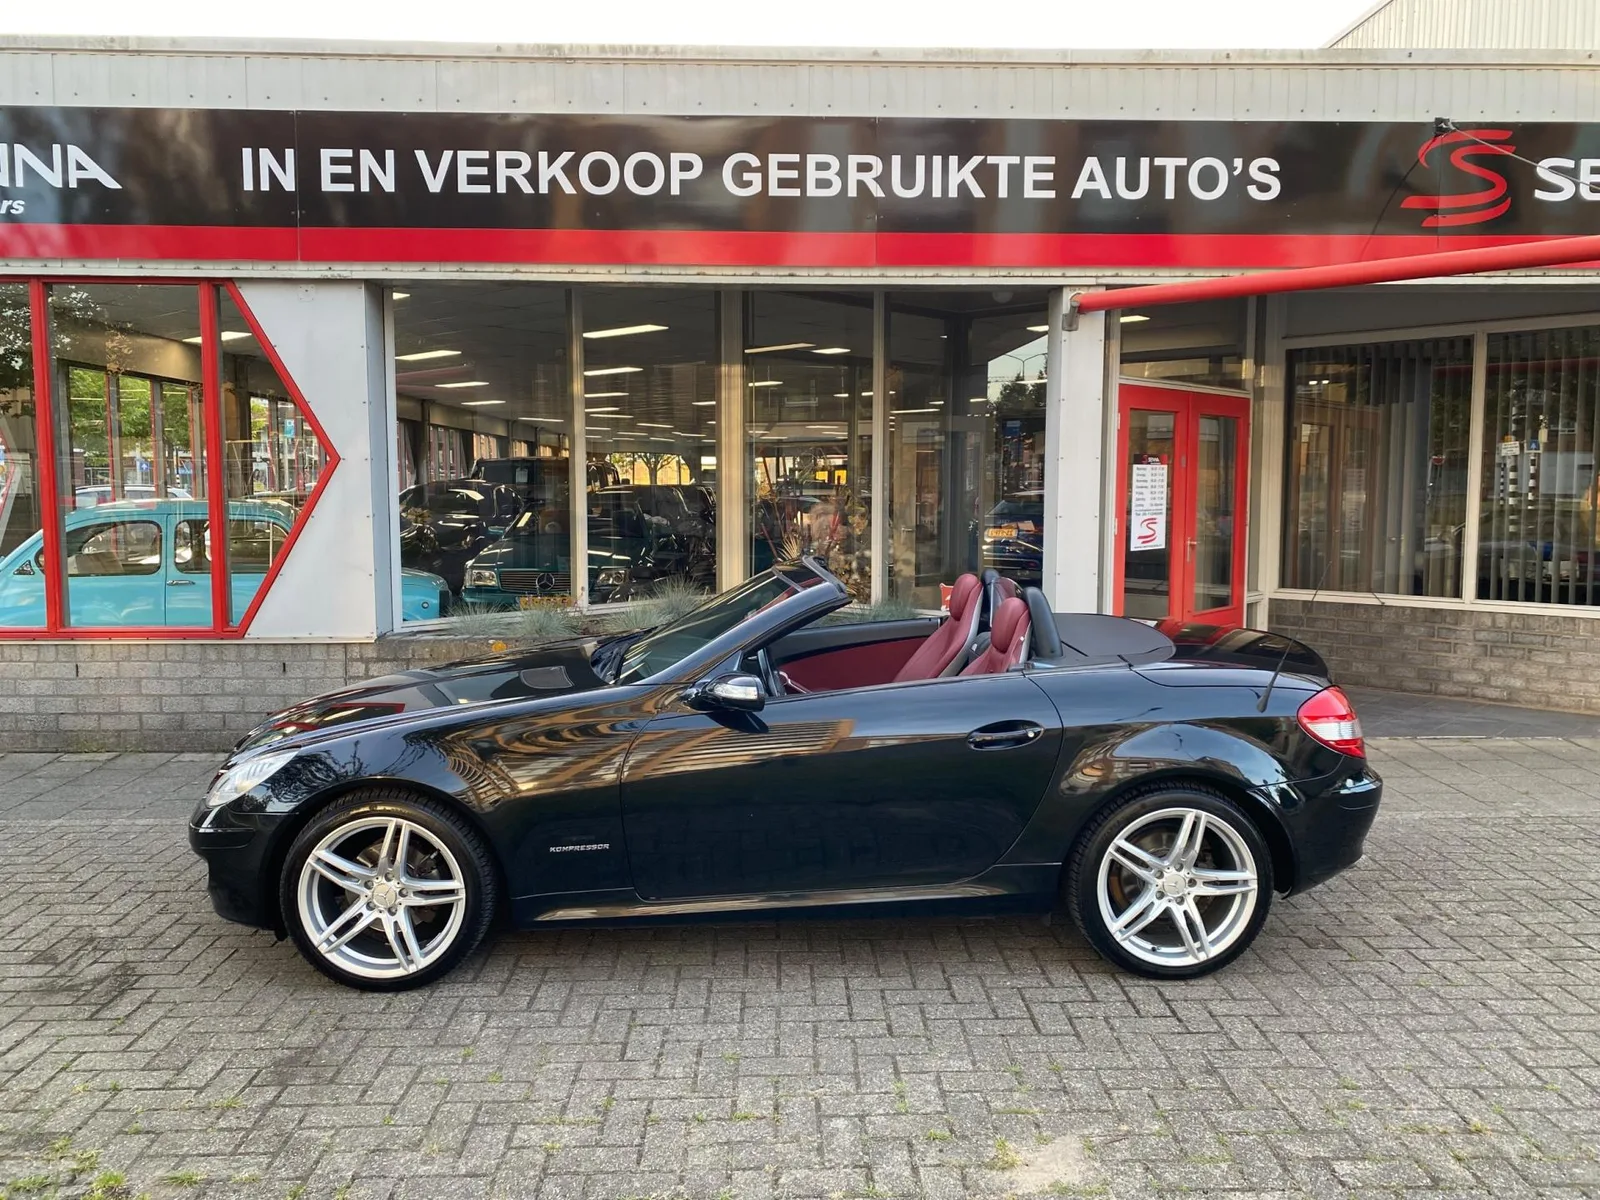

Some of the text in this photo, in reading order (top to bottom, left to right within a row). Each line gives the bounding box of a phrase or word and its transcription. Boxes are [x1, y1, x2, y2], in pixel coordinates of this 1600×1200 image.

[0, 143, 123, 189] NA
[242, 147, 1281, 201] IN EN VERKOOP GEBRUIKTE AUTO’S
[549, 843, 611, 853] KOMPRESSOR
